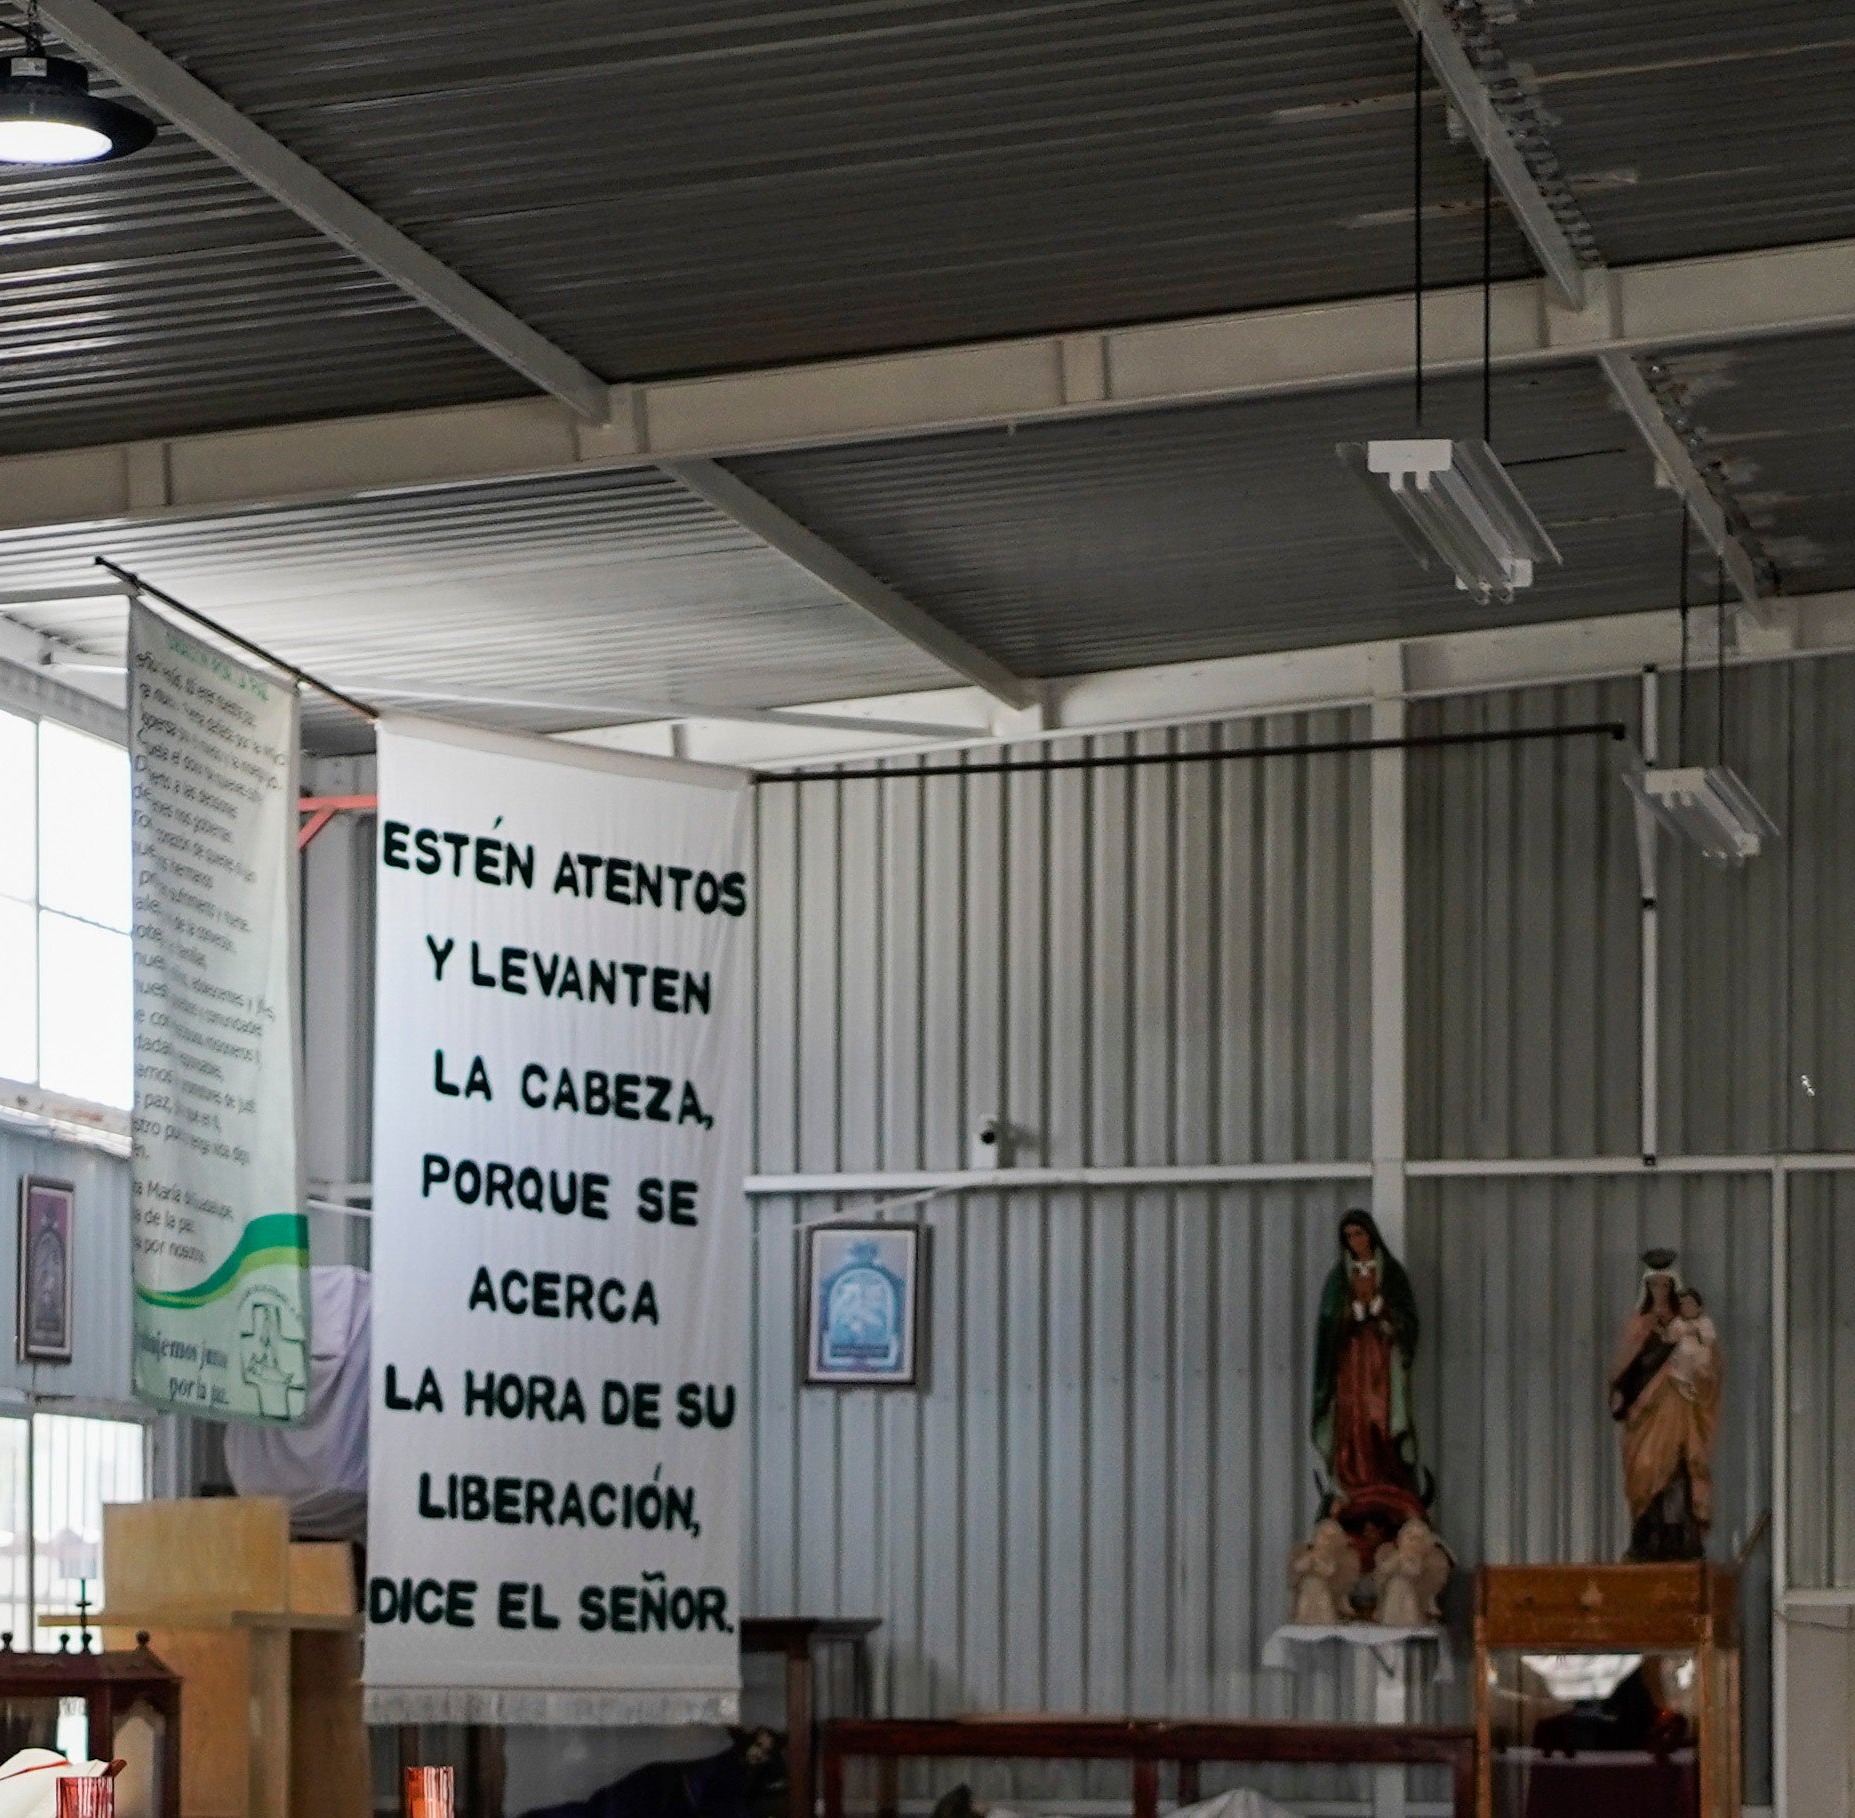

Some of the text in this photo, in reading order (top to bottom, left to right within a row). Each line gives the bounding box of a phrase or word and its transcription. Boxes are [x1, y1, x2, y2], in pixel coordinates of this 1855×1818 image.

[383, 815, 748, 918] ESTÉN ATENTOS
[425, 934, 712, 1016] Y LEVANTEN
[434, 1049, 715, 1132] LA CABEZA,
[422, 1153, 700, 1228] PORQUE SE
[468, 1264, 661, 1327] ACERCA
[384, 1363, 737, 1431] LA HORA DE SU
[418, 1462, 702, 1539] LIBERACIÓN,
[368, 1569, 736, 1636] DICE EL SEÑOR.
